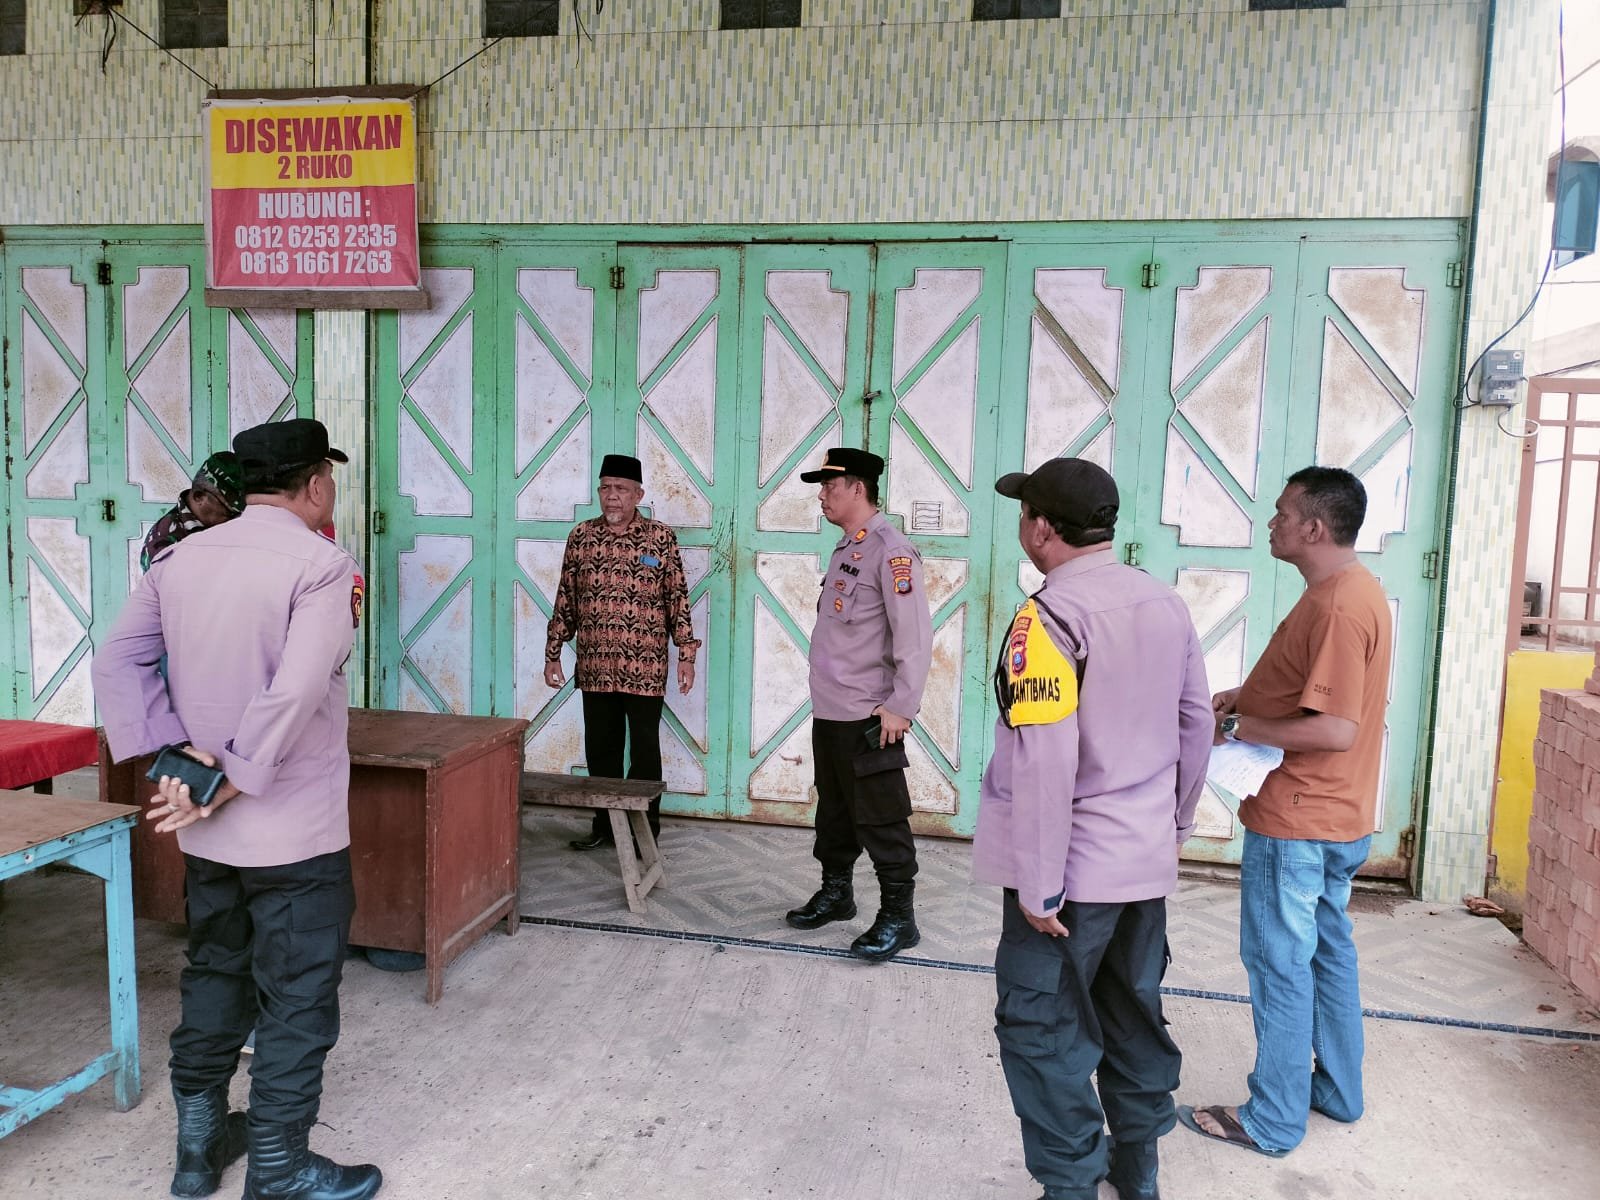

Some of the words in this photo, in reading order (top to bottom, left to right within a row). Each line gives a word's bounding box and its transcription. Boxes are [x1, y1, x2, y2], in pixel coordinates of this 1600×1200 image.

[225, 114, 403, 154] DISEWAKAN
[277, 155, 291, 180] 2
[296, 154, 353, 179] RUKO
[234, 225, 283, 249] 0812
[287, 224, 340, 248] 6253
[344, 224, 397, 248] 2335
[240, 251, 289, 275] 0813
[293, 251, 339, 274] 1661
[343, 250, 392, 274] 7263
